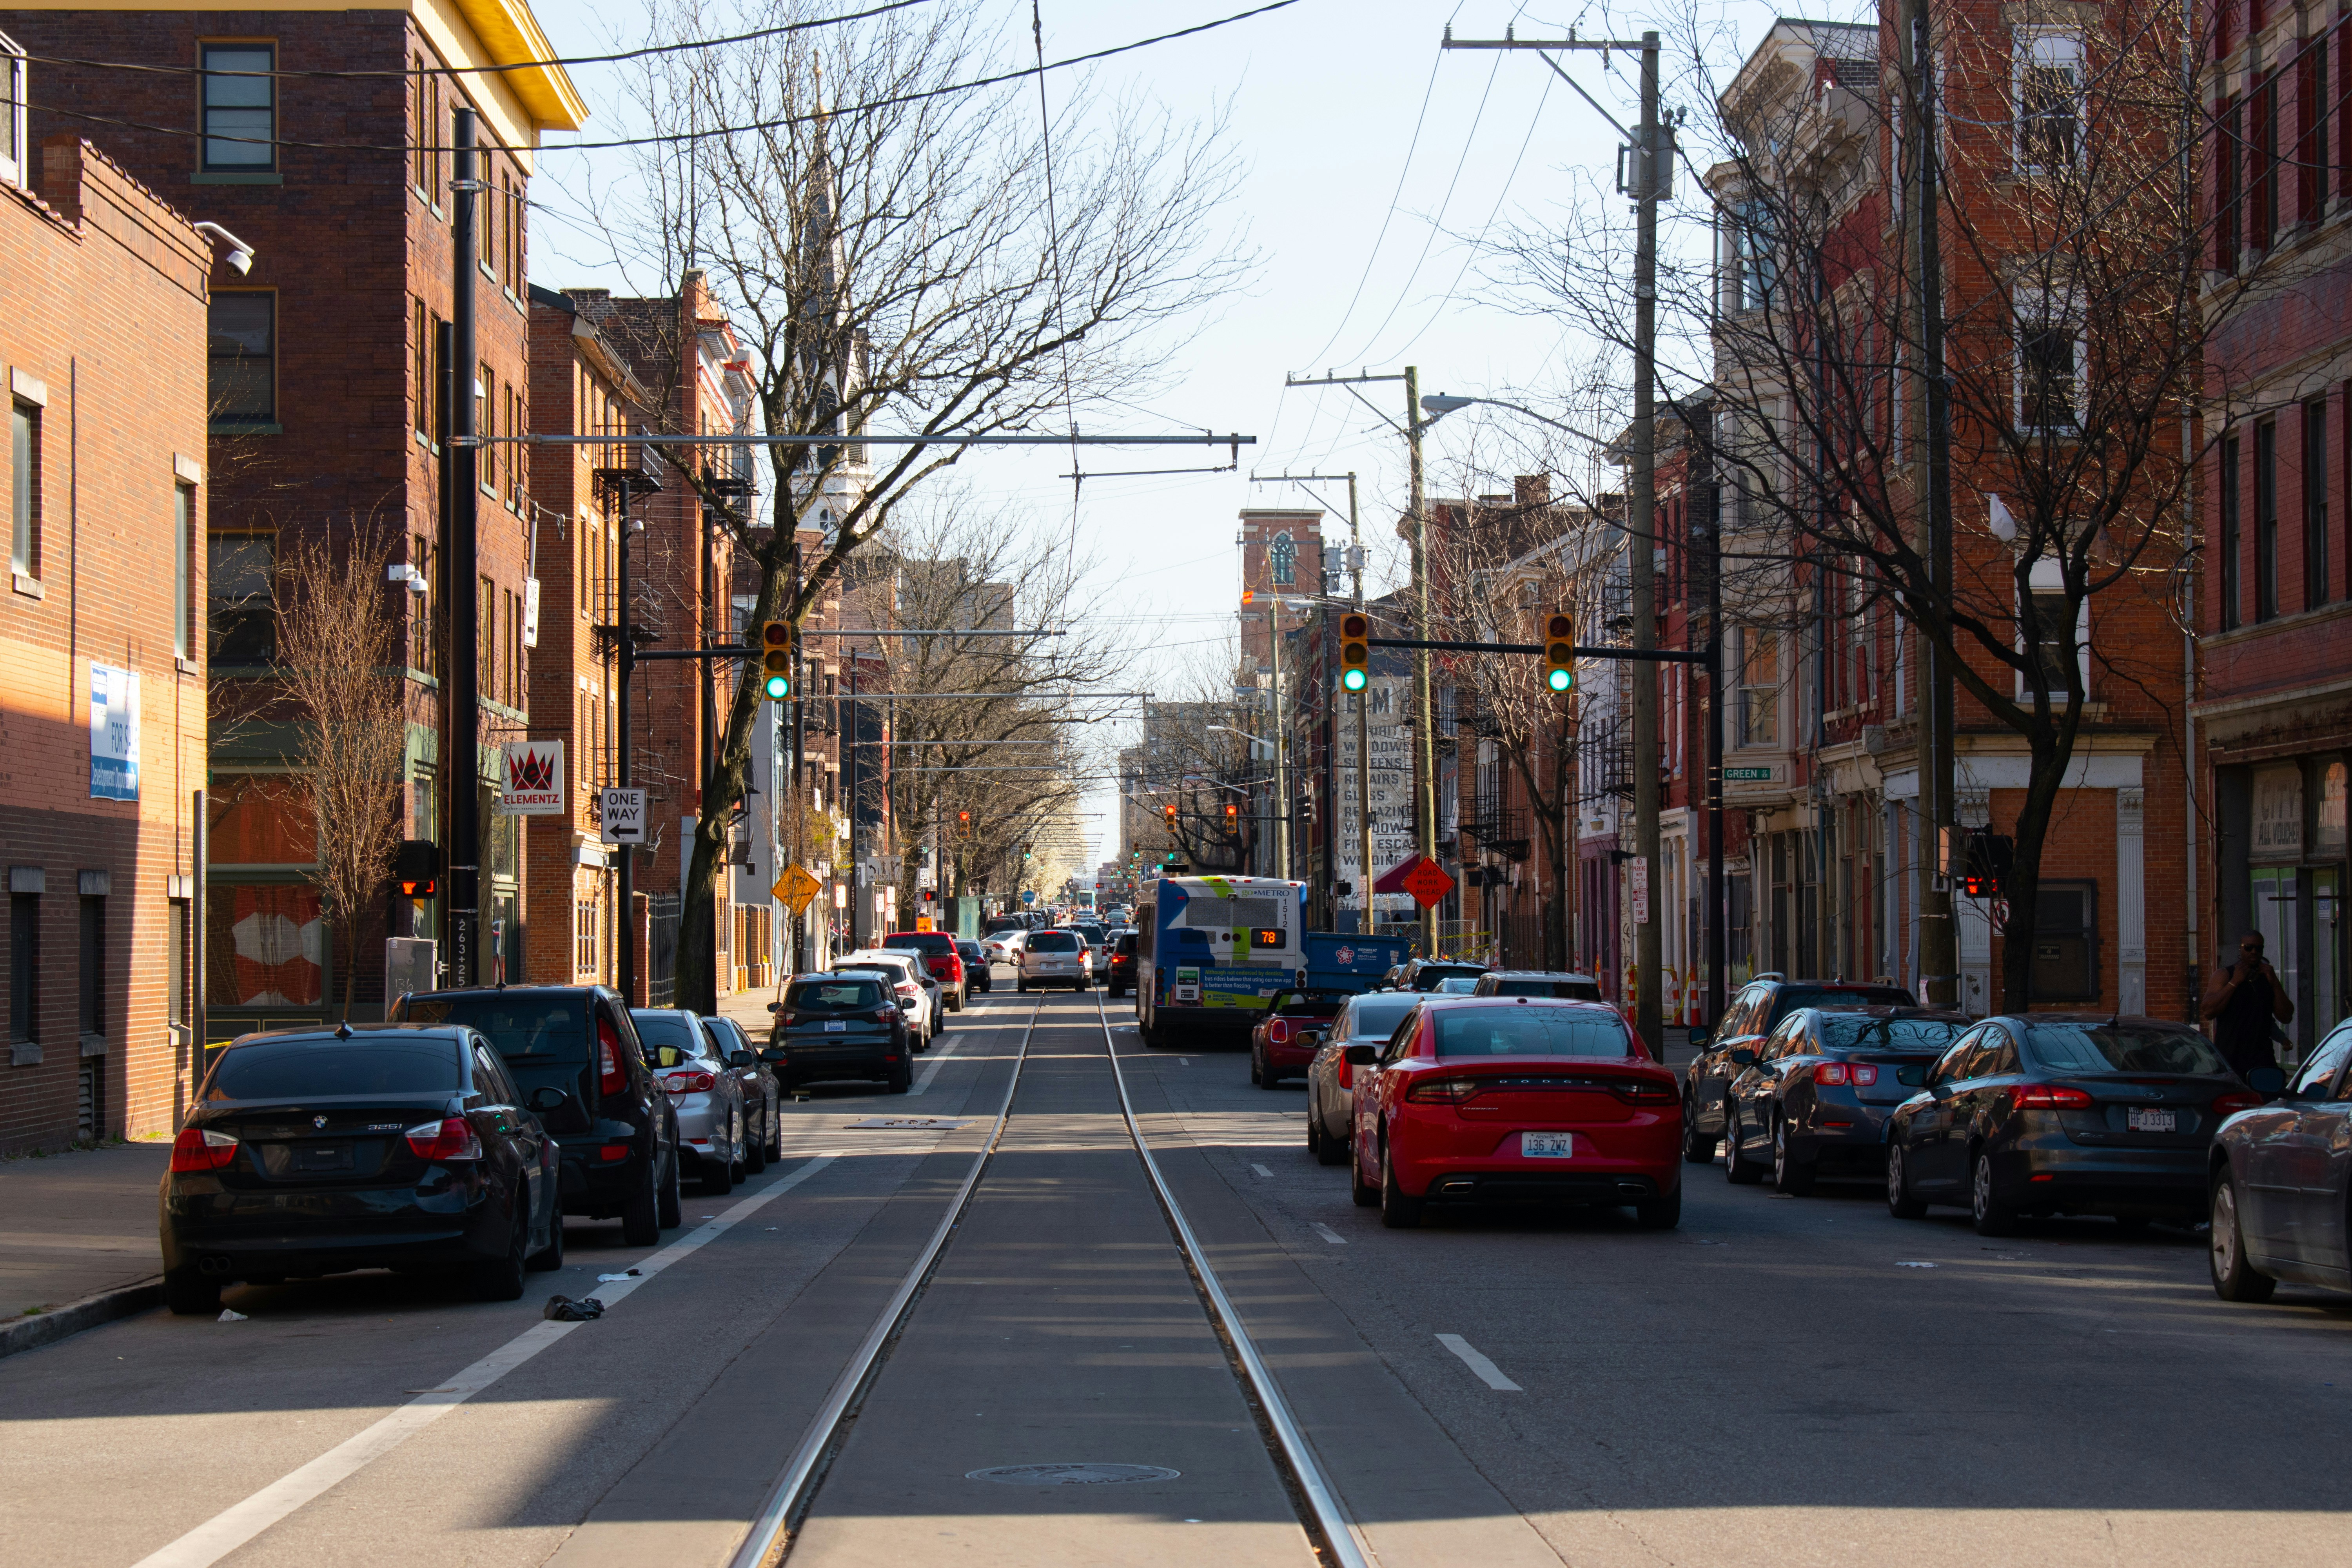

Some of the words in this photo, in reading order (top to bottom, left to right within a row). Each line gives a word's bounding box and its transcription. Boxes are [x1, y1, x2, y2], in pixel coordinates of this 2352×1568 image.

[112, 722, 123, 753] FOR
[1343, 742, 1412, 752] WDOWS
[1344, 758, 1402, 768] SCEENS
[1345, 774, 1399, 784] REAIRS
[1727, 769, 1757, 778] GREEN
[504, 794, 560, 805] ELEMENTZ
[609, 793, 639, 805] ONE
[1345, 790, 1385, 801] GLSS
[608, 808, 639, 820] WAY
[1345, 806, 1412, 817] REAZING
[1345, 823, 1402, 833] WDOW
[2258, 822, 2270, 845] ALL
[1378, 839, 1410, 849] ESCA
[1343, 855, 1401, 866] WDING
[1262, 932, 1275, 943] 78
[2150, 1114, 2172, 1126] 3313
[1528, 1140, 1544, 1151] 136
[1550, 1140, 1567, 1151] ZWZ
